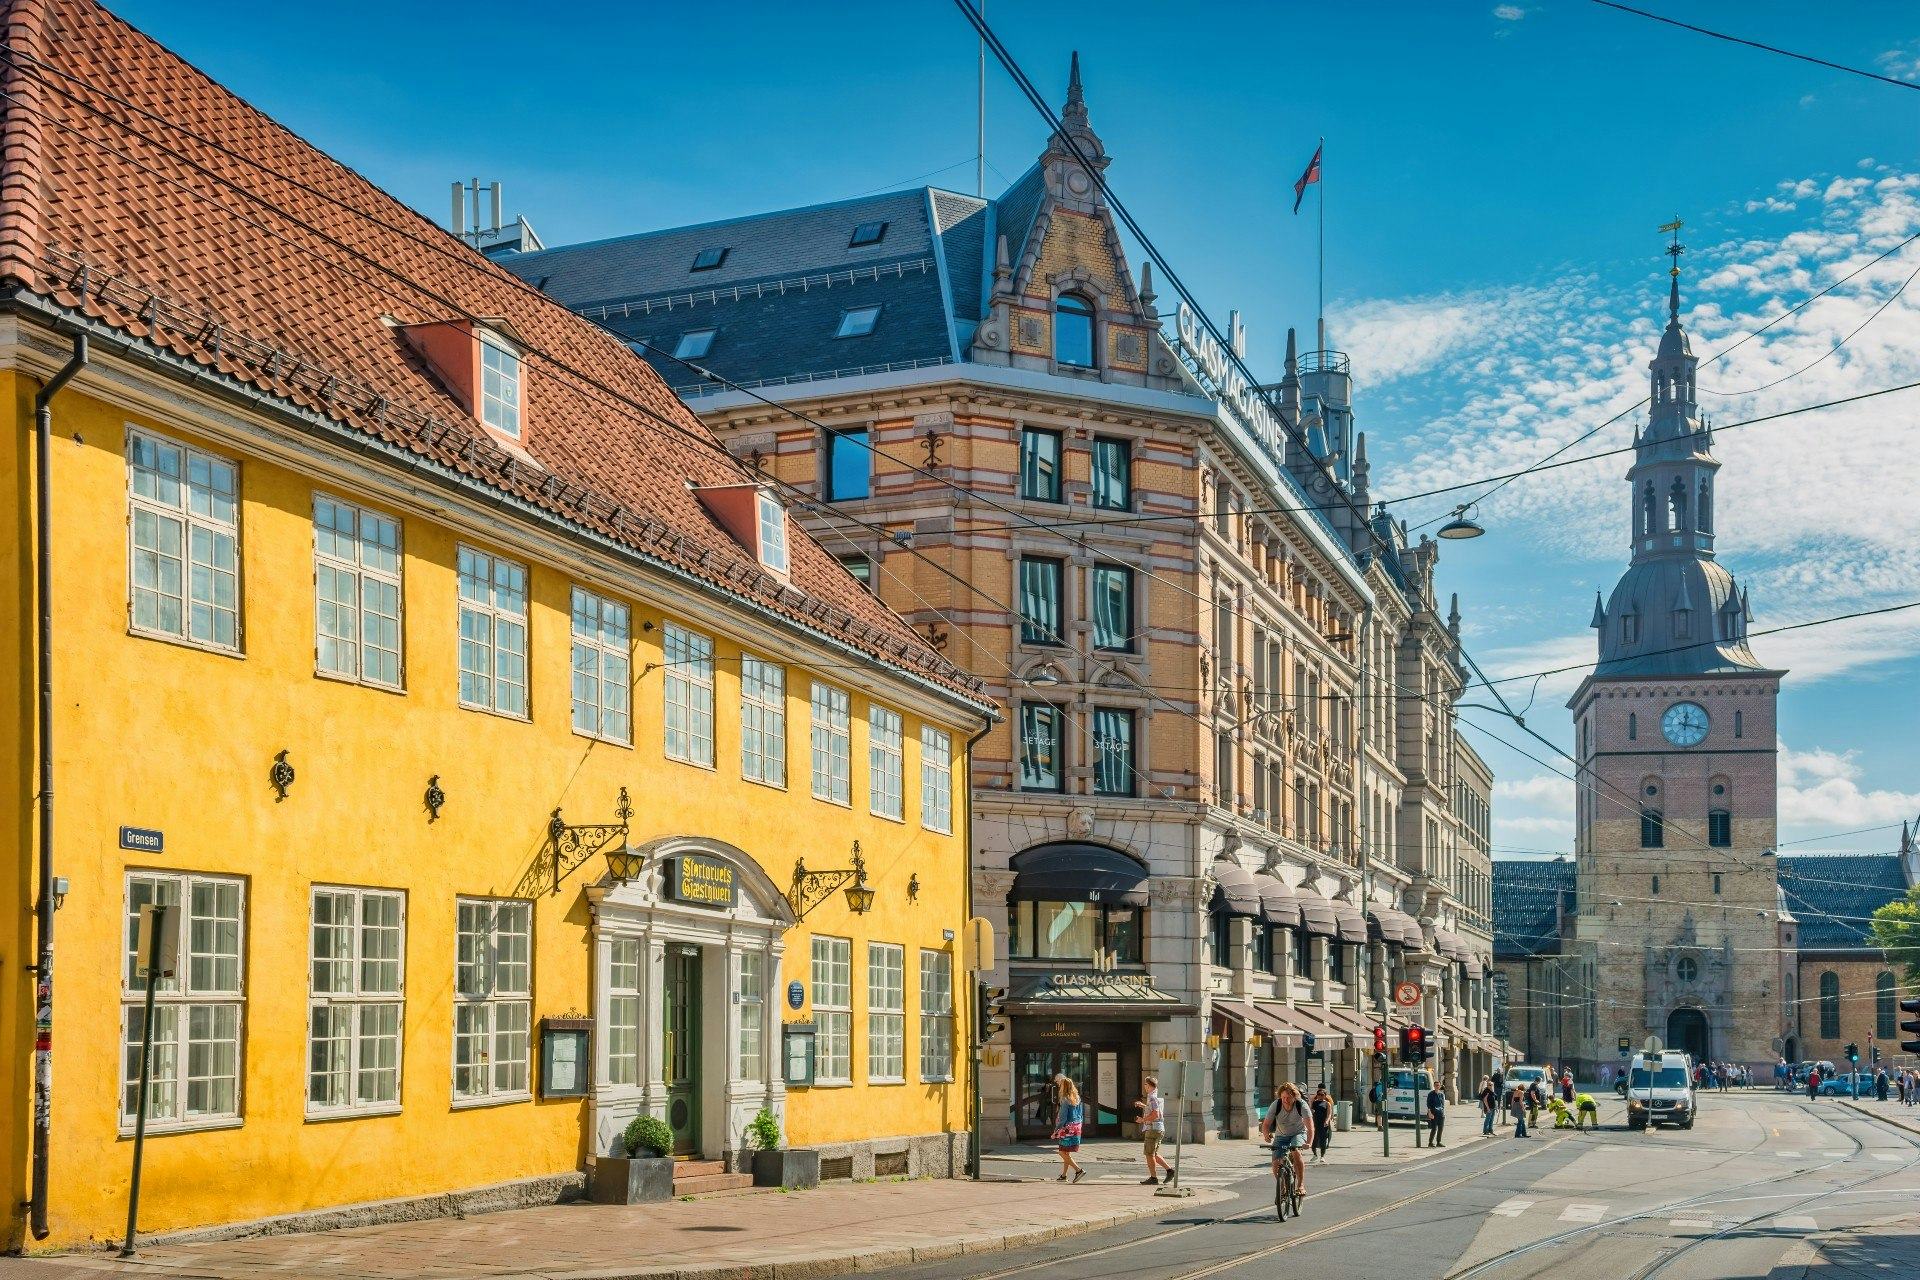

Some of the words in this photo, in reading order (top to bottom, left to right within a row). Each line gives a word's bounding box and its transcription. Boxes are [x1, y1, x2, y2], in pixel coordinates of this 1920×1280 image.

[1176, 302, 1288, 465] GLASMAGASINET
[127, 830, 159, 847] Grensen
[682, 857, 732, 884] Stortorvets
[1053, 974, 1157, 987] GLASMAGASINET
